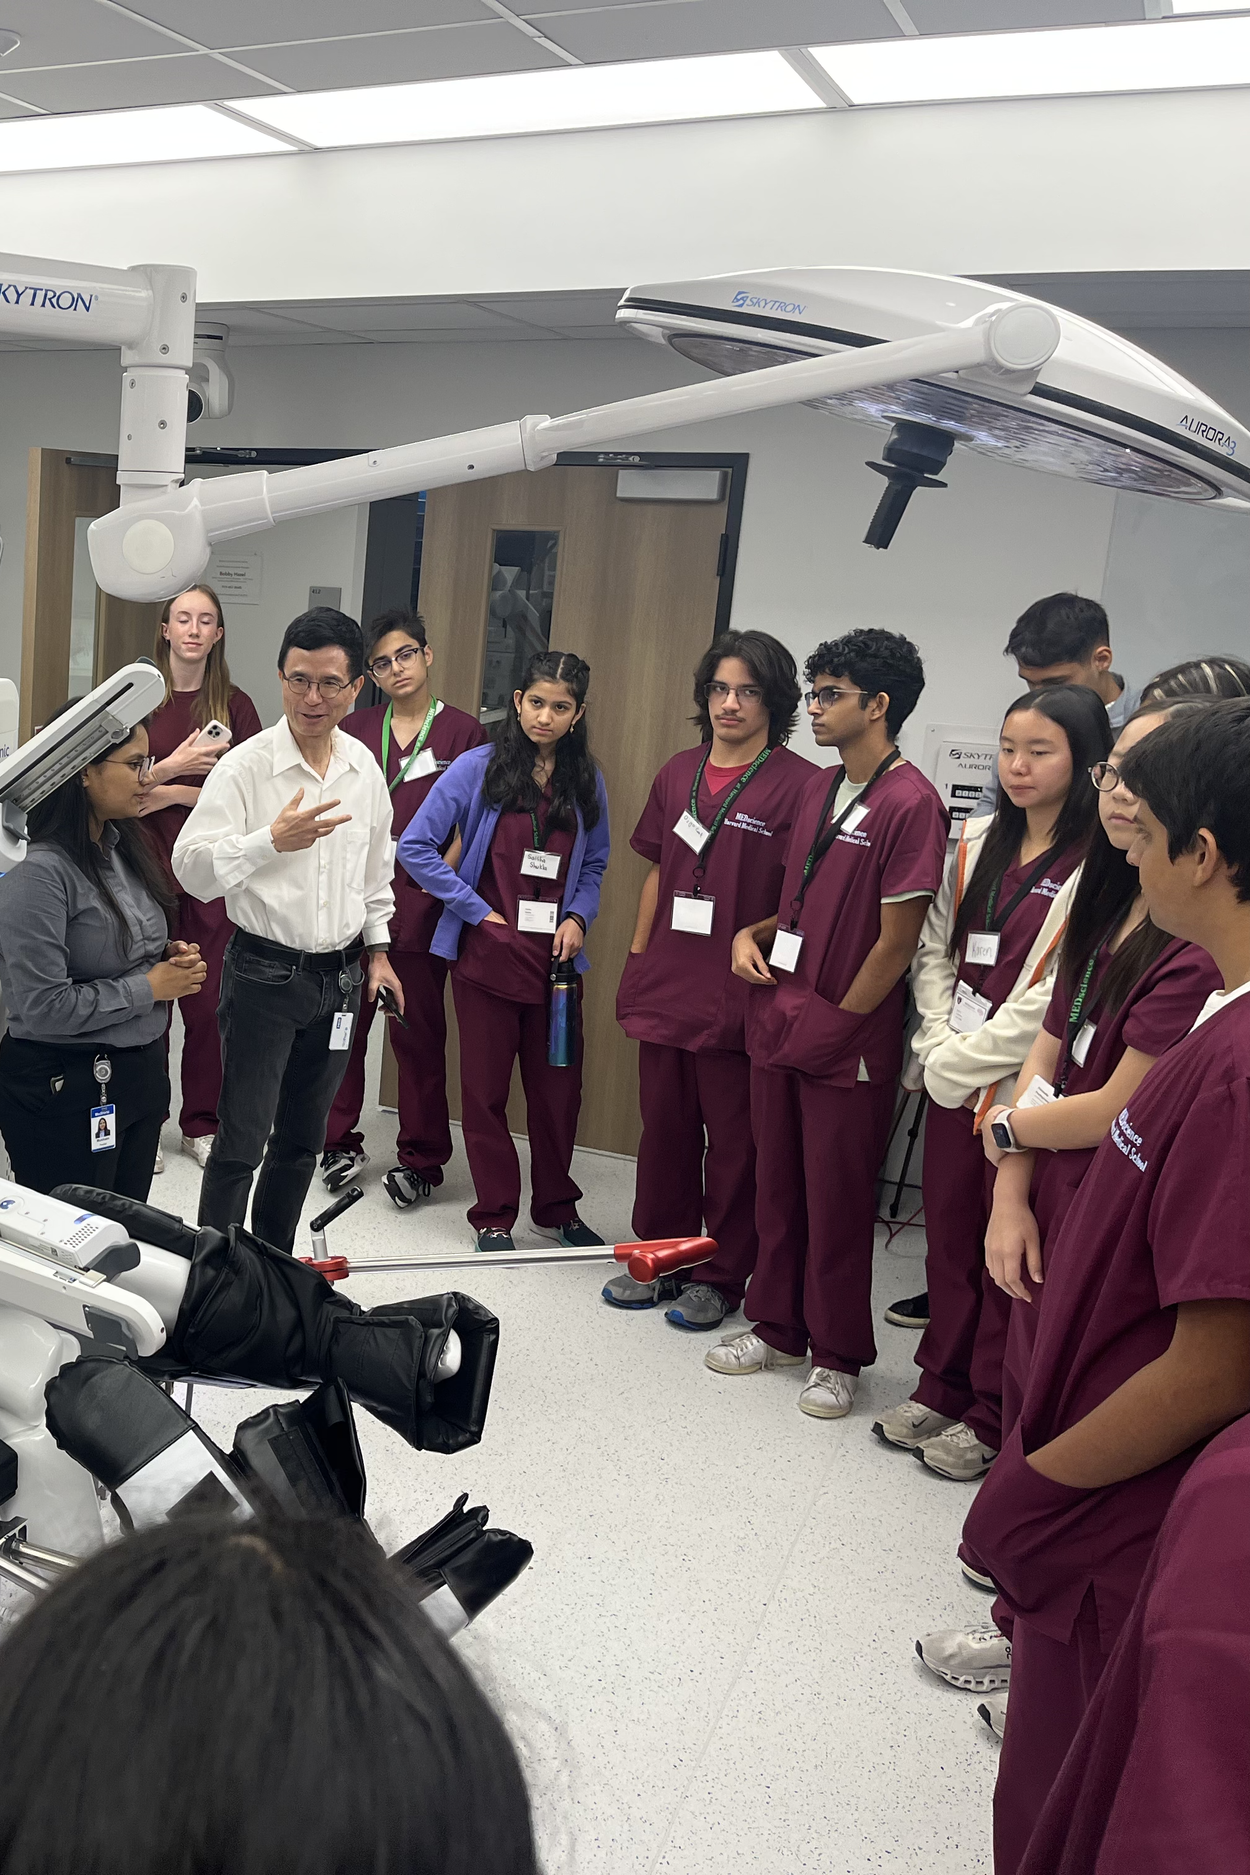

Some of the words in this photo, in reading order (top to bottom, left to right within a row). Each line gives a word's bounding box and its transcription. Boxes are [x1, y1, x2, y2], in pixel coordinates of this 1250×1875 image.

[746, 296, 807, 315] SKYTRON
[957, 762, 992, 771] AUROR
[971, 941, 993, 959] Karen
[1069, 959, 1095, 1023] MEDscience
